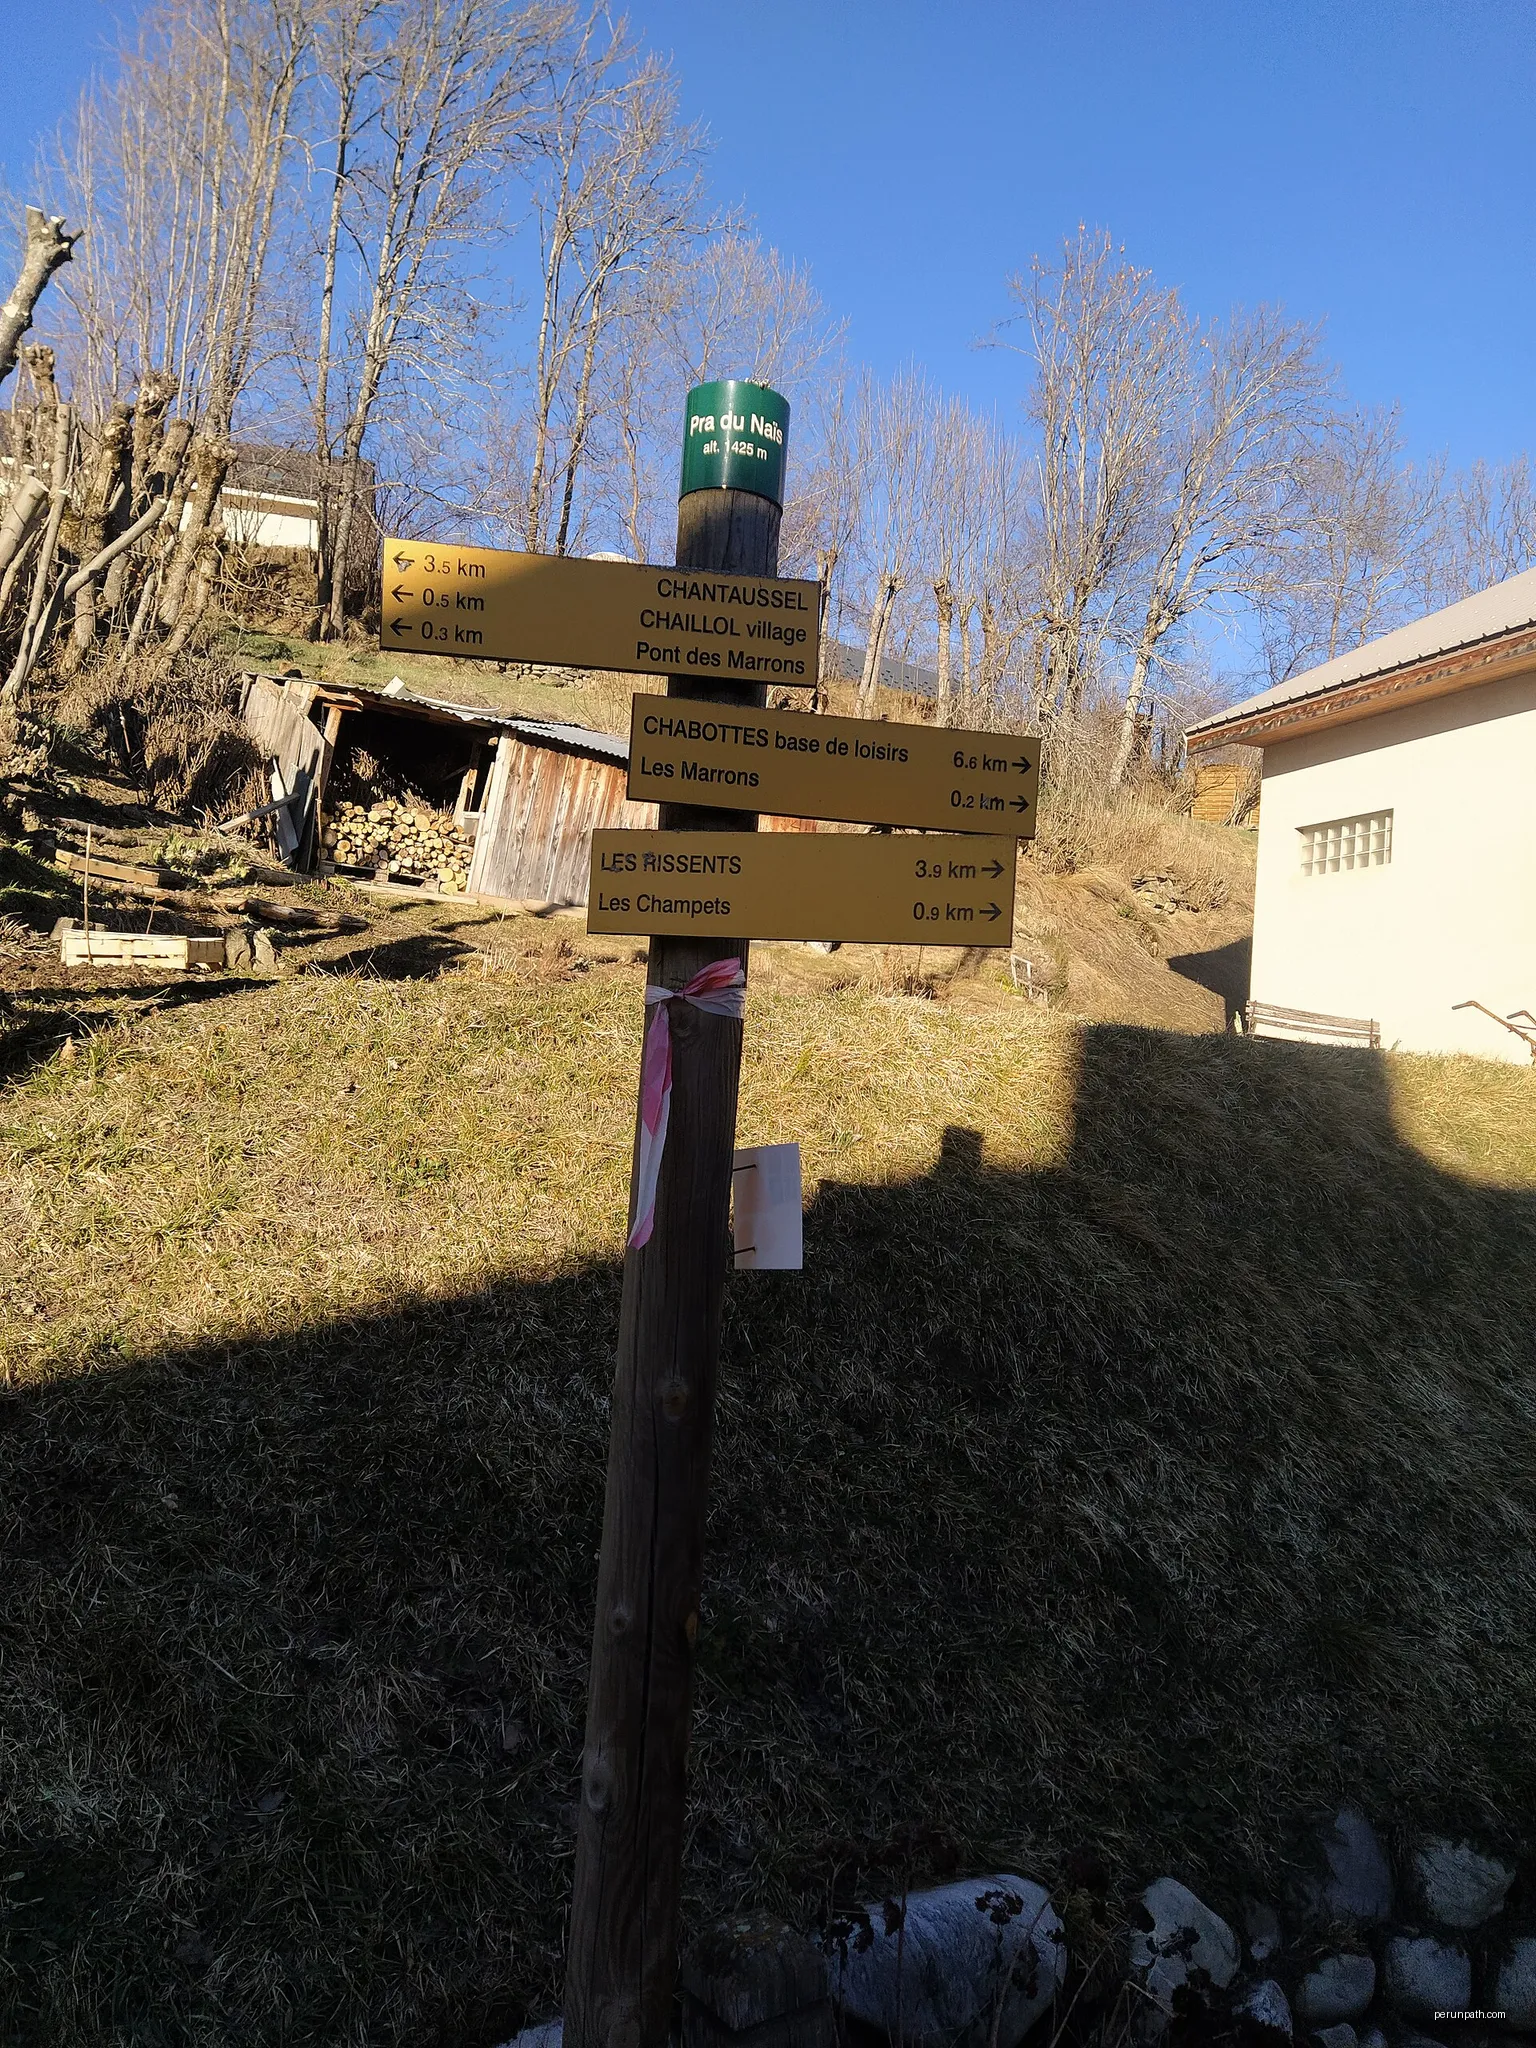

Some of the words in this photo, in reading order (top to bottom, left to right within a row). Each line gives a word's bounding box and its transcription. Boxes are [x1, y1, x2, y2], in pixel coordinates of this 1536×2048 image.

[690, 414, 715, 437] Pra
[720, 410, 745, 431] du
[750, 413, 783, 445] Naïs
[703, 440, 720, 455] alt.
[757, 447, 767, 460] m
[423, 554, 451, 575] 3.5
[457, 558, 486, 578] km
[422, 588, 449, 608] 0.5
[455, 591, 484, 611] km
[657, 578, 808, 611] CHANTAUSSEL
[421, 620, 448, 641] 0.3
[454, 624, 483, 645] km
[640, 609, 741, 637] CHAILLOL
[746, 620, 807, 646] village
[636, 641, 681, 664] Pont
[686, 646, 721, 667] des
[727, 650, 805, 675] Marrons
[643, 715, 769, 748] CHABOTTES
[775, 731, 820, 753] base
[825, 737, 849, 756] de
[854, 739, 909, 763] loisirs
[640, 757, 674, 778] Les
[680, 760, 760, 788] Marrons
[953, 750, 978, 770] 6.6
[982, 754, 1008, 773] km
[950, 790, 975, 809] 0.2
[980, 793, 1005, 812] km
[600, 852, 637, 873] LES
[642, 852, 742, 875] RISSENTS
[914, 859, 943, 879] 3.9
[948, 861, 976, 879] km
[598, 892, 631, 912] Les
[636, 893, 731, 919] Champets
[912, 901, 940, 922] 0.9
[945, 903, 974, 921] km
